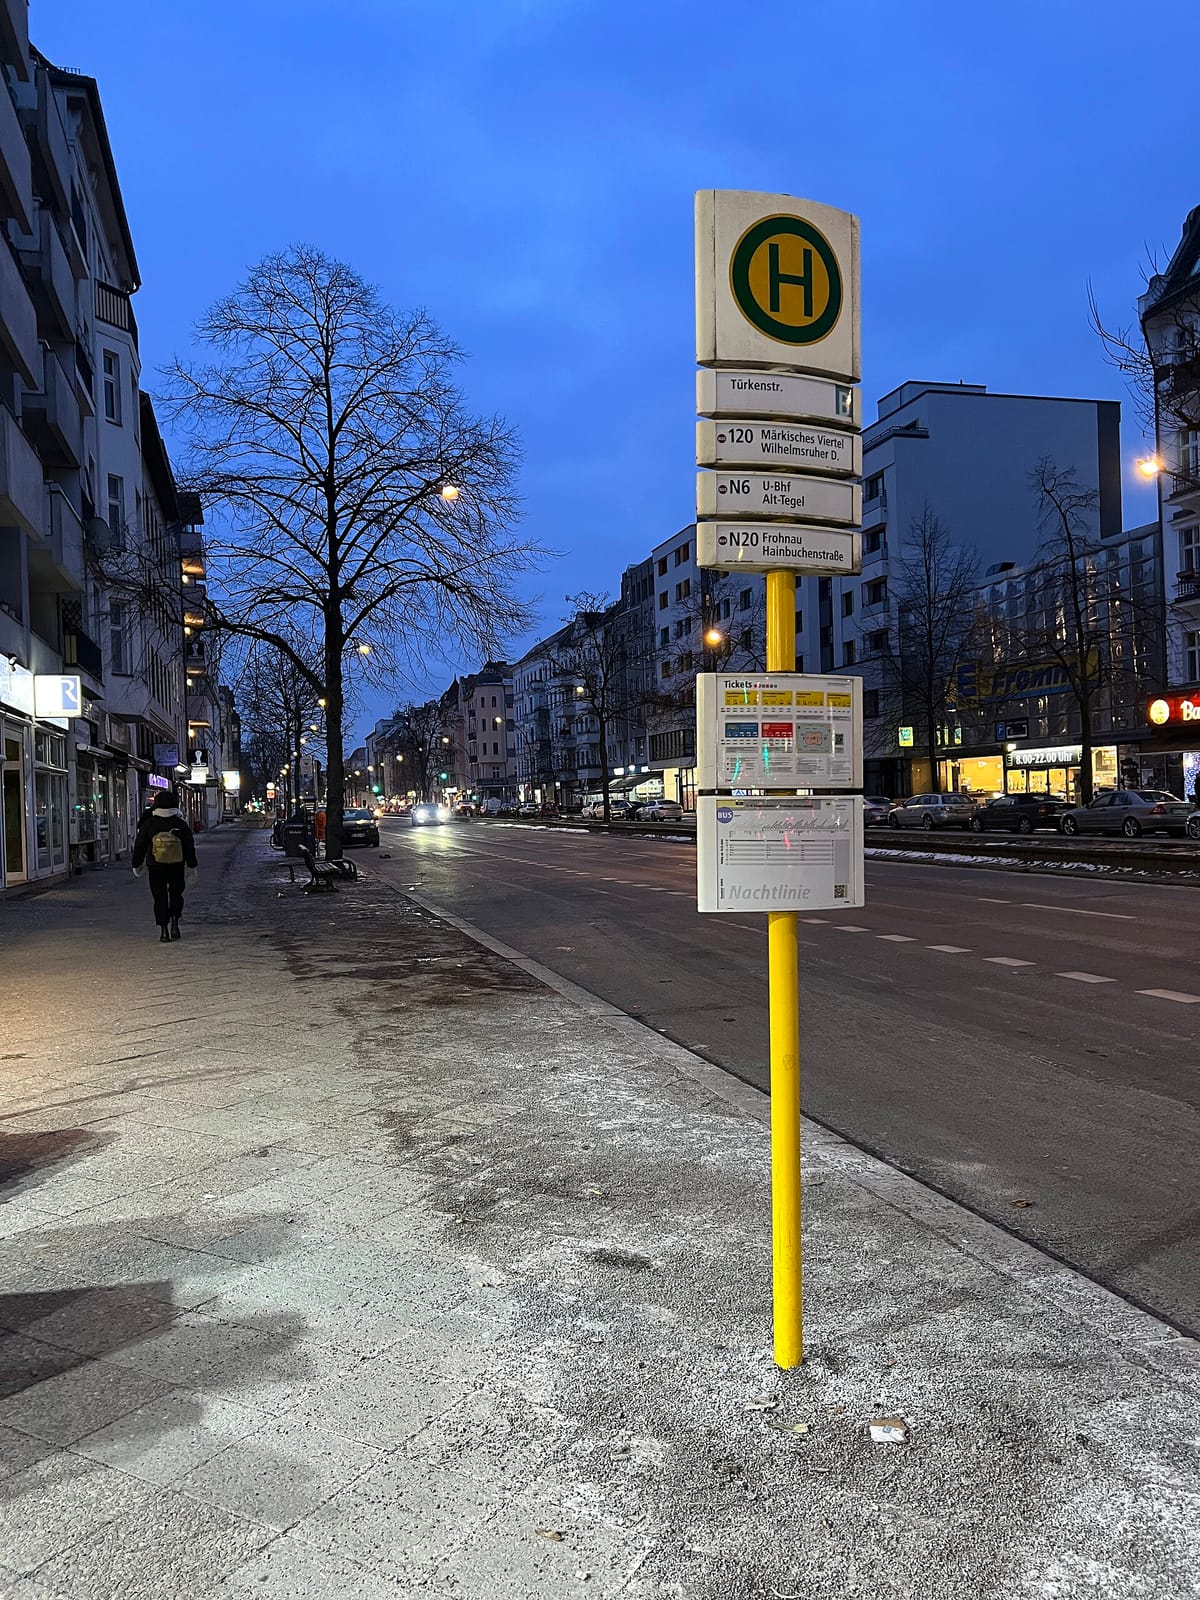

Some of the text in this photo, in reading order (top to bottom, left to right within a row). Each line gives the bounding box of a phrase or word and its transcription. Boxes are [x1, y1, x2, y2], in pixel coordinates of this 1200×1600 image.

[768, 242, 814, 318] H
[730, 379, 784, 393] Türkenstr.
[728, 428, 754, 444] 120
[761, 429, 815, 444] Märkisches
[817, 434, 844, 450] Viertel
[761, 442, 840, 462] Wilhelmsruher D.
[729, 479, 751, 495] N6
[762, 480, 792, 493] U-Bhf
[762, 494, 805, 509] Alt-Tegel
[729, 532, 760, 547] N20
[762, 532, 802, 545] Frohnau
[762, 546, 844, 562] Hainbuchenstraße
[724, 680, 752, 689] Tickets
[1015, 752, 1057, 765] 8.00-22.00
[1058, 750, 1073, 762] Uhr
[717, 811, 733, 819] BUS
[729, 884, 811, 900] Nachtlinie
